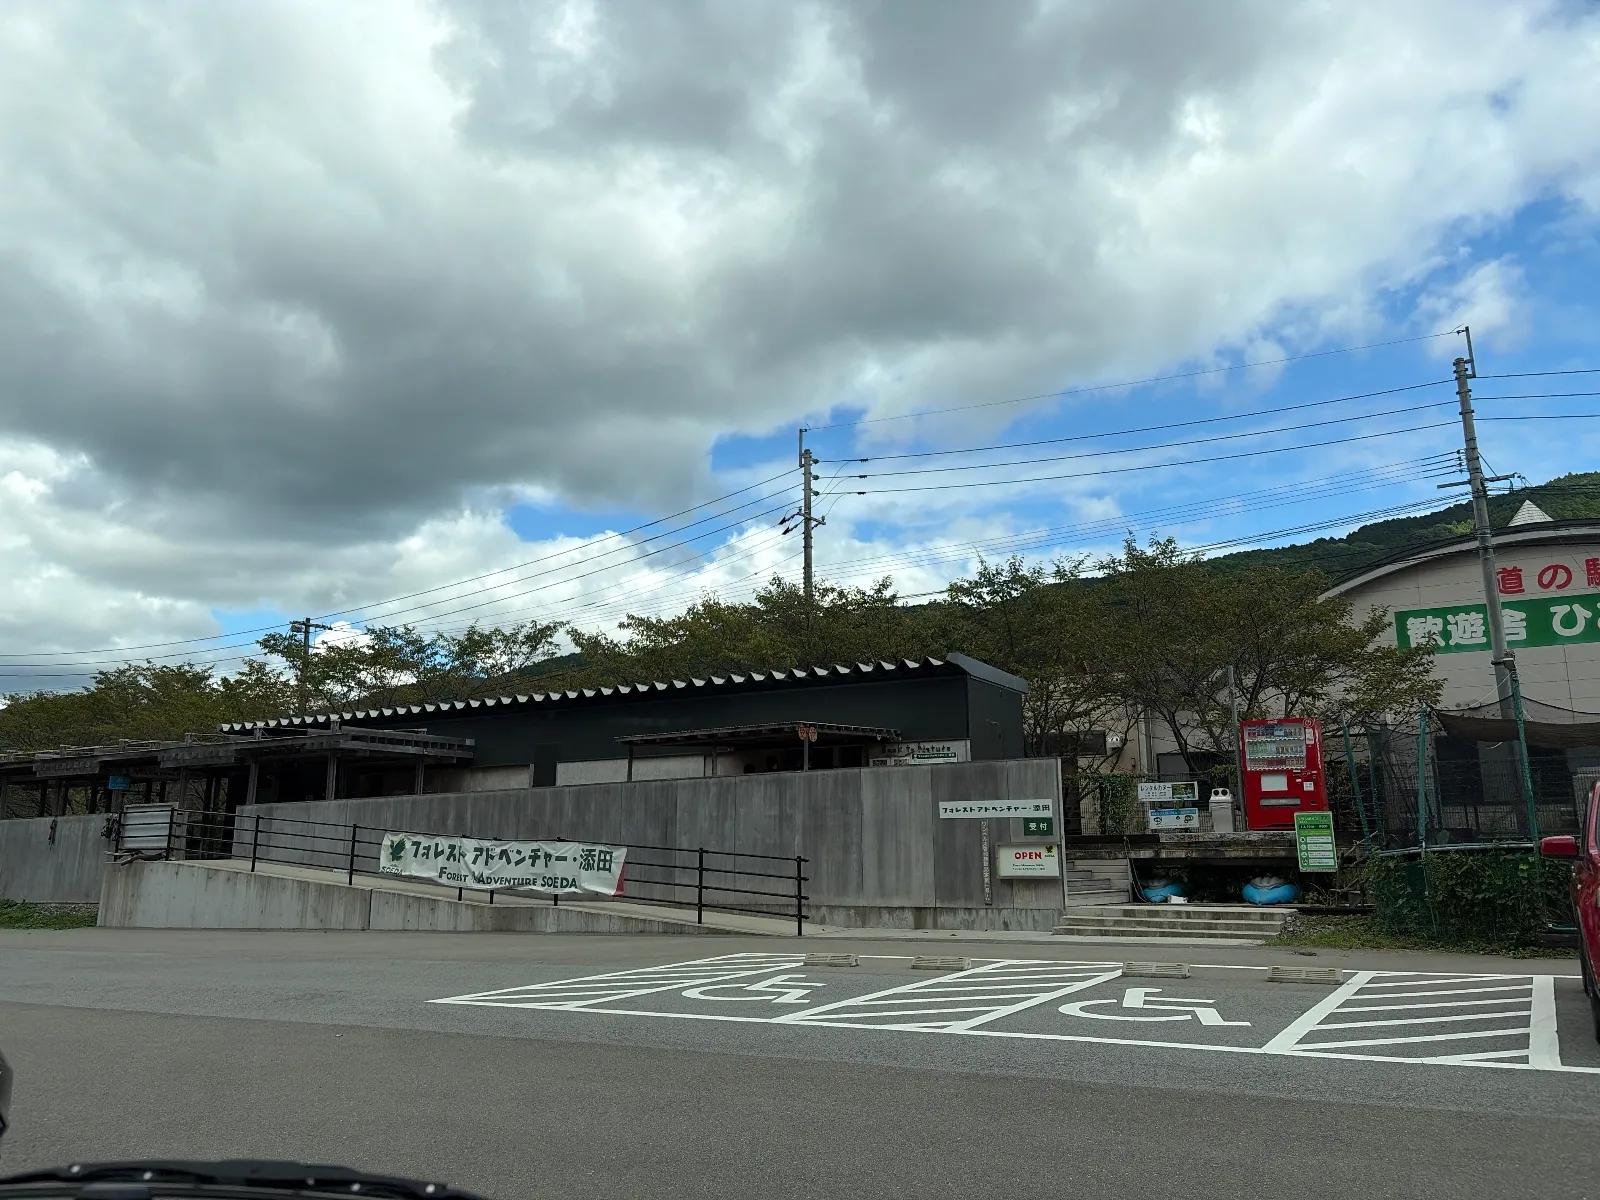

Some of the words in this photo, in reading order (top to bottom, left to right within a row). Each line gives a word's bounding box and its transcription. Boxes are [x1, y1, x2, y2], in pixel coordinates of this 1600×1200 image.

[1550, 603, 1600, 637] ひ
[1014, 851, 1043, 860] OPEN
[540, 875, 578, 889] SOEDA
